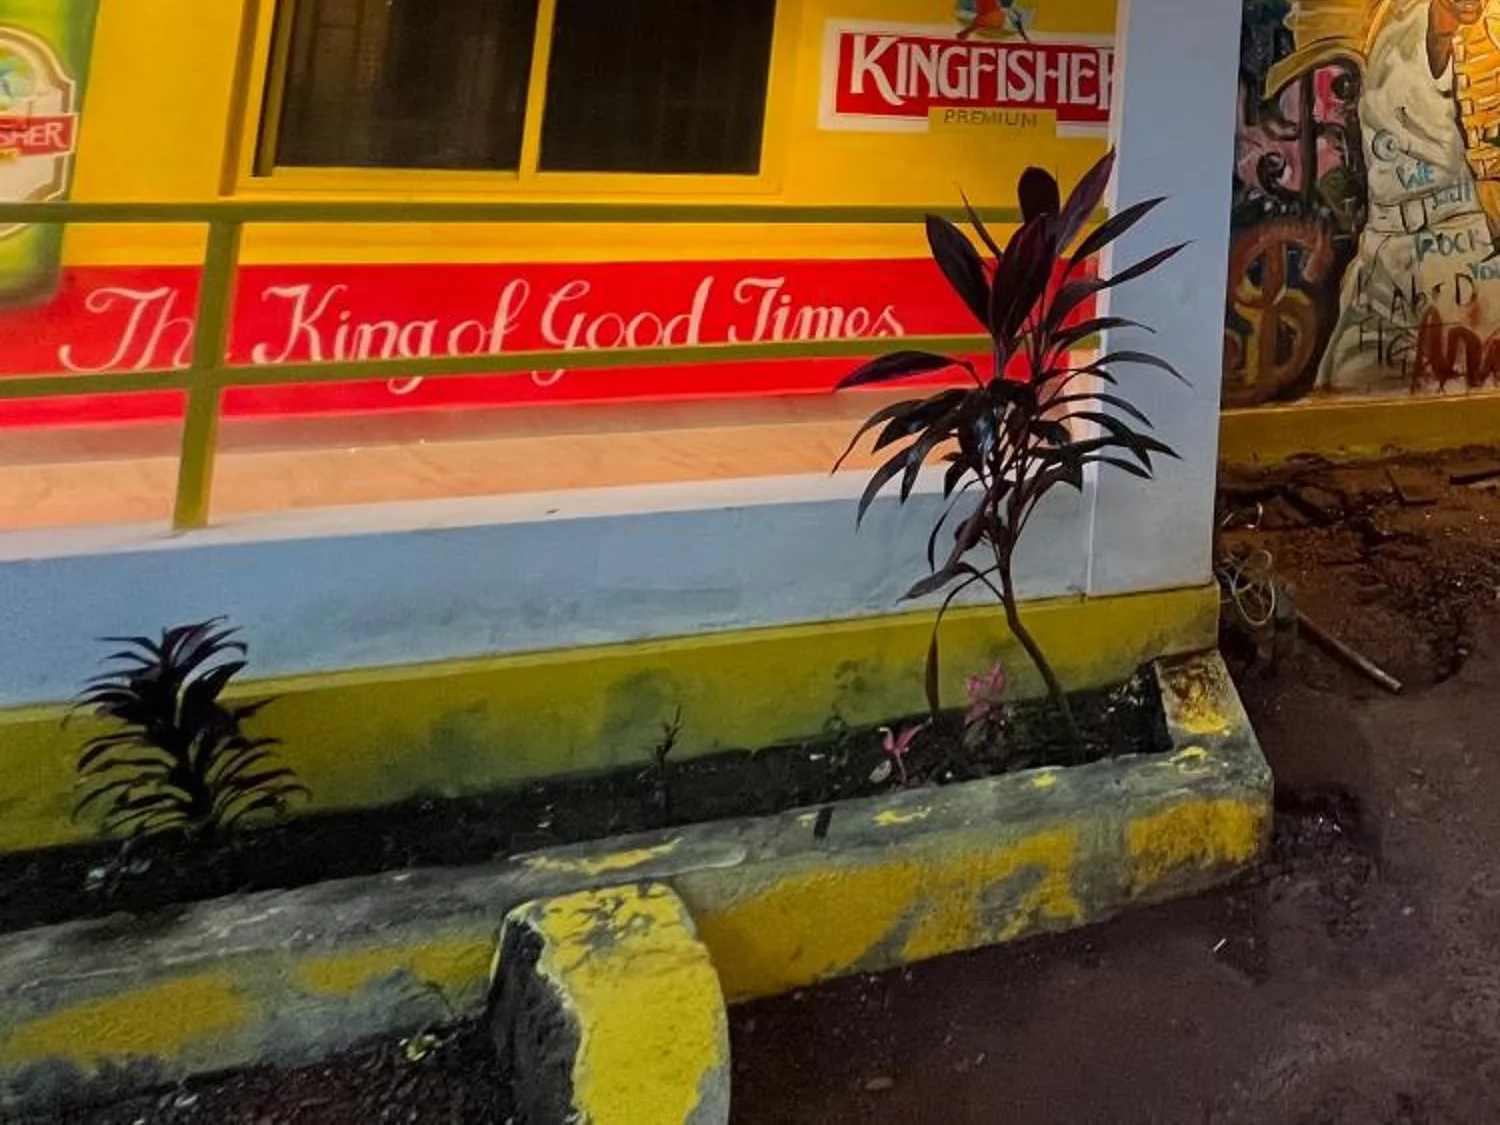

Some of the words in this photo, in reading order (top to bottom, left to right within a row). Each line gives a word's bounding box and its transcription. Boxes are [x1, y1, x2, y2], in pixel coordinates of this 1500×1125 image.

[944, 108, 1038, 128] PREMIUM
[58, 285, 233, 373] Th
[251, 283, 439, 395] King
[448, 279, 530, 357] of
[531, 276, 715, 386] Good
[727, 276, 906, 345] Times
